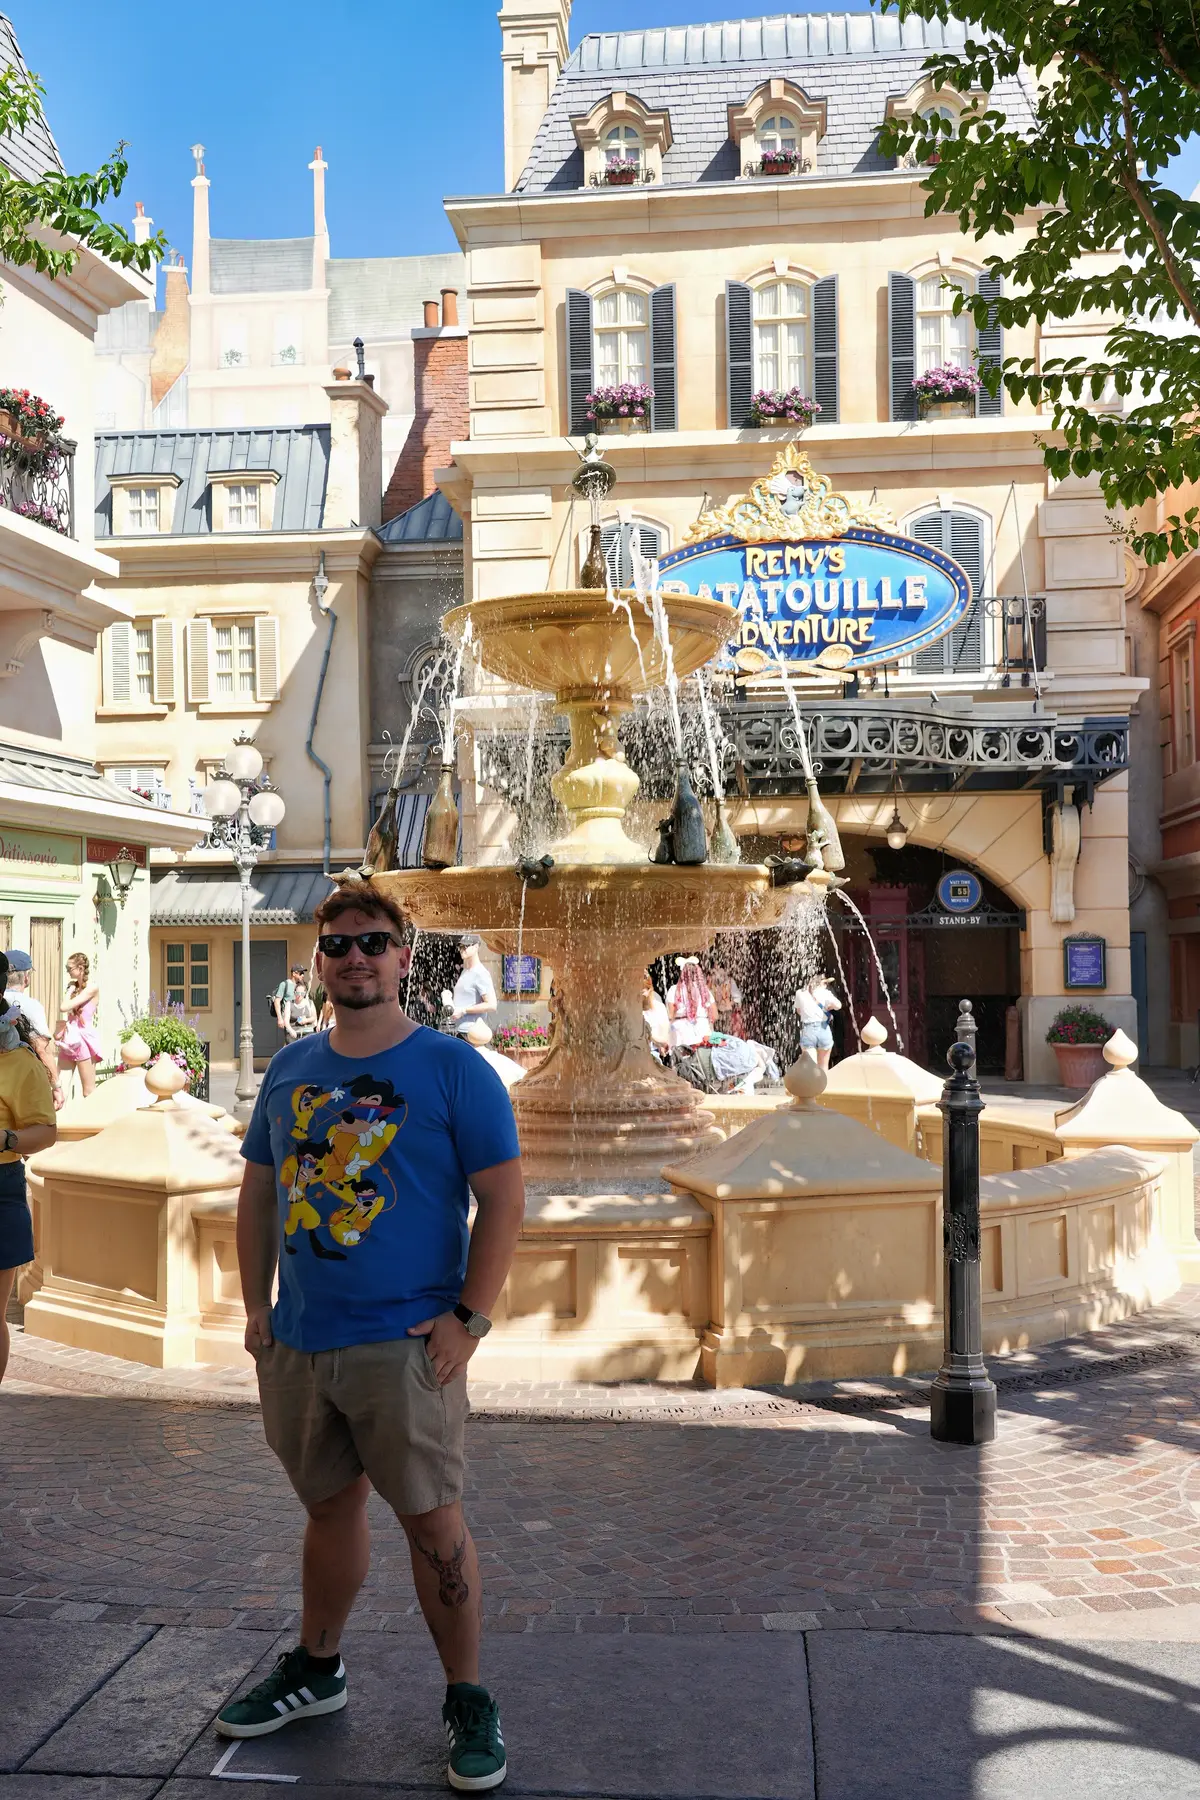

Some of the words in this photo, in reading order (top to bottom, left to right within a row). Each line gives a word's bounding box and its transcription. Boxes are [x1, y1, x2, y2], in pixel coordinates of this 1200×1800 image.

[745, 545, 846, 579] REMY'S
[736, 614, 876, 645] DVENTURE
[957, 887, 967, 895] 55
[939, 916, 981, 925] STAND-BY
